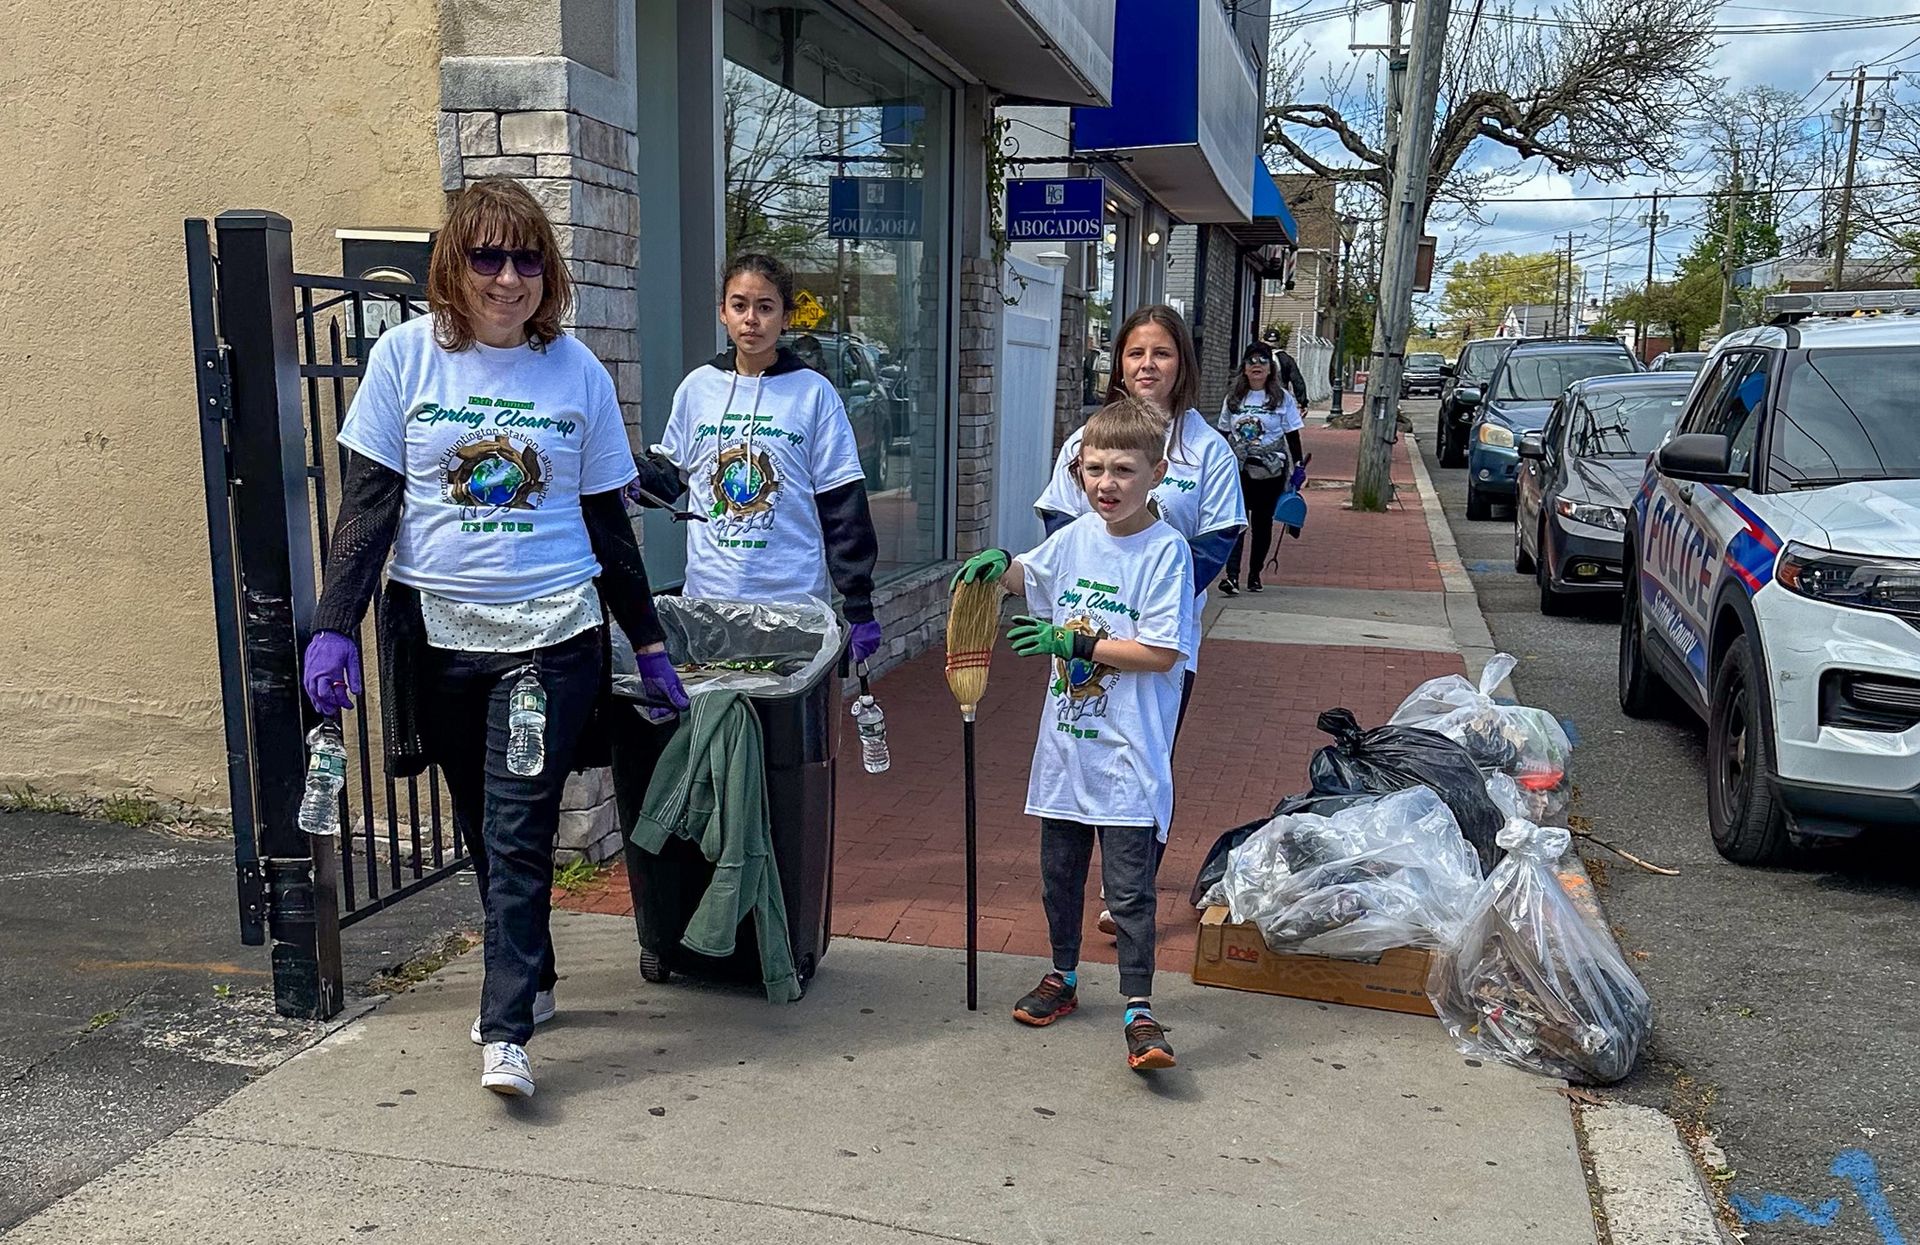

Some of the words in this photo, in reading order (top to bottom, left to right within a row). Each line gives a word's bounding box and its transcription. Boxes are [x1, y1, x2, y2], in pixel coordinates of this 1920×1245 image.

[1009, 218, 1100, 236] ABOGADOS
[416, 404, 485, 429] Spring
[494, 409, 576, 438] Clean-up
[443, 428, 499, 459] Huntington
[503, 428, 539, 451] Station
[1646, 495, 1718, 621] POLICE
[1088, 609, 1111, 632] Station
[1651, 589, 1676, 625] Suffolk
[1670, 611, 1697, 662] County
[1227, 944, 1260, 961] Dole
